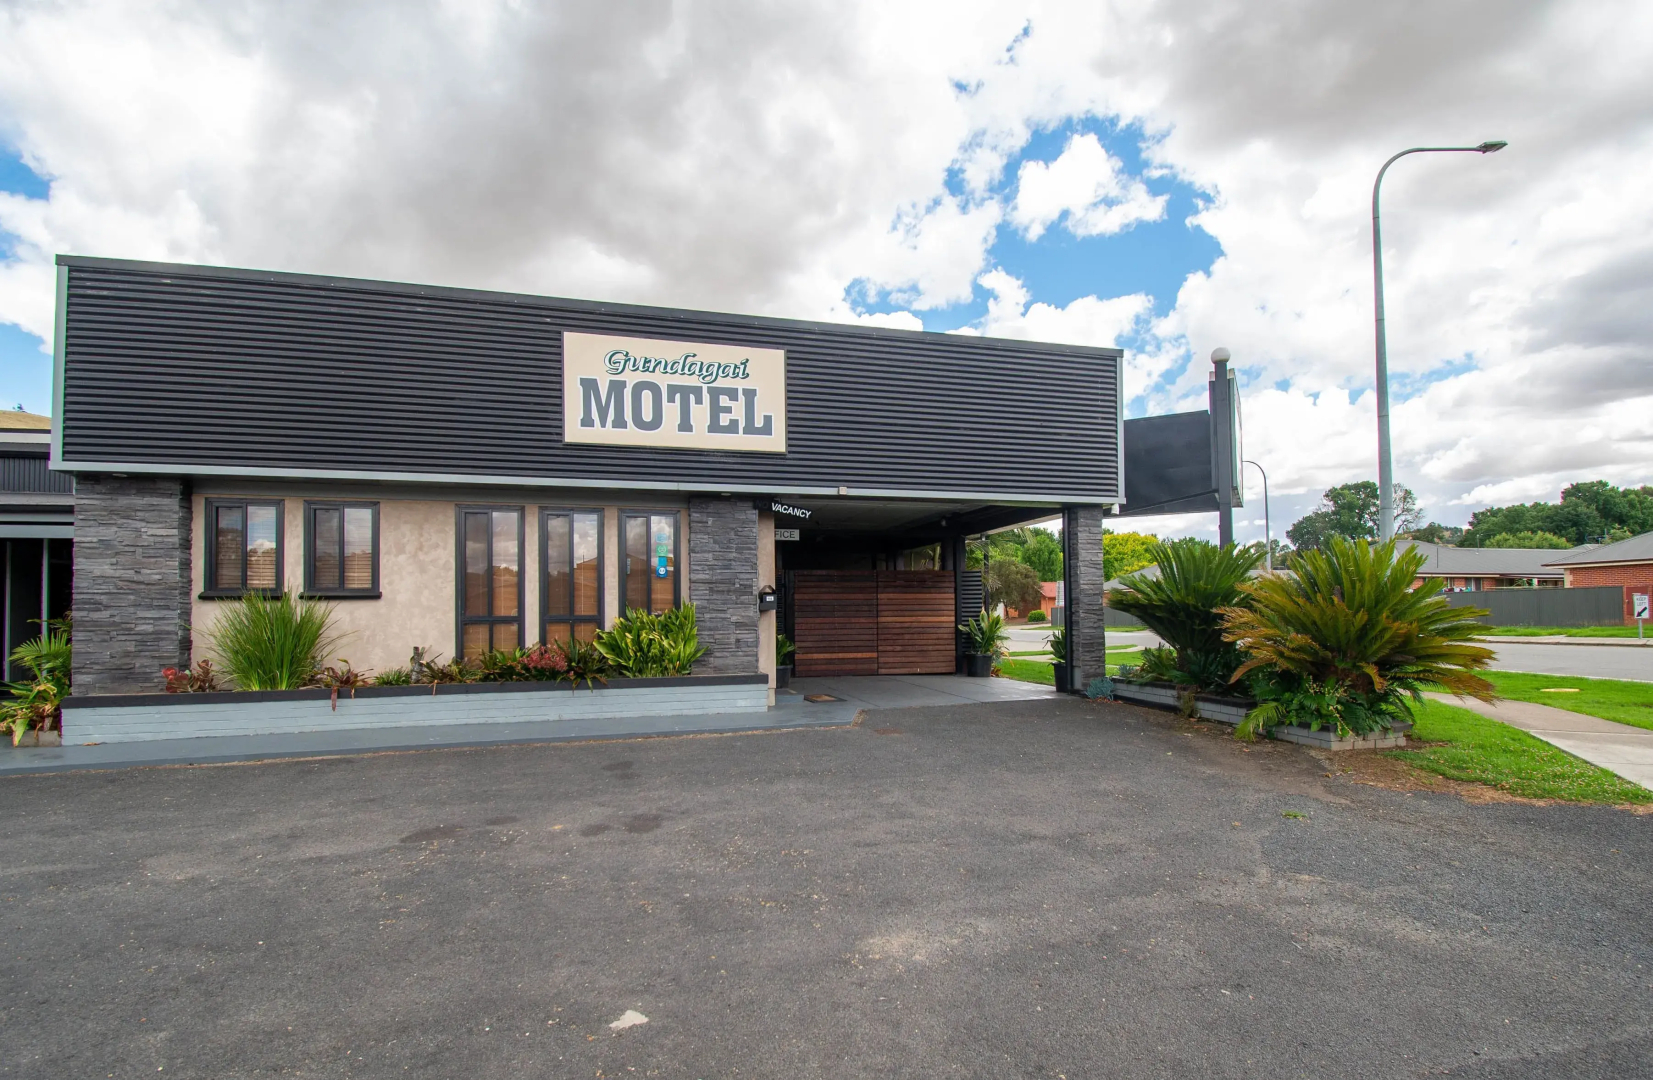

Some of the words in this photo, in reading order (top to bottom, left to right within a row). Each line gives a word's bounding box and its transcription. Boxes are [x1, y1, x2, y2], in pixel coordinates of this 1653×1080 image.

[603, 350, 749, 384] Gundagai
[578, 376, 774, 437] MOTEL
[771, 502, 812, 519] VACANCY
[774, 530, 796, 539] FICE
